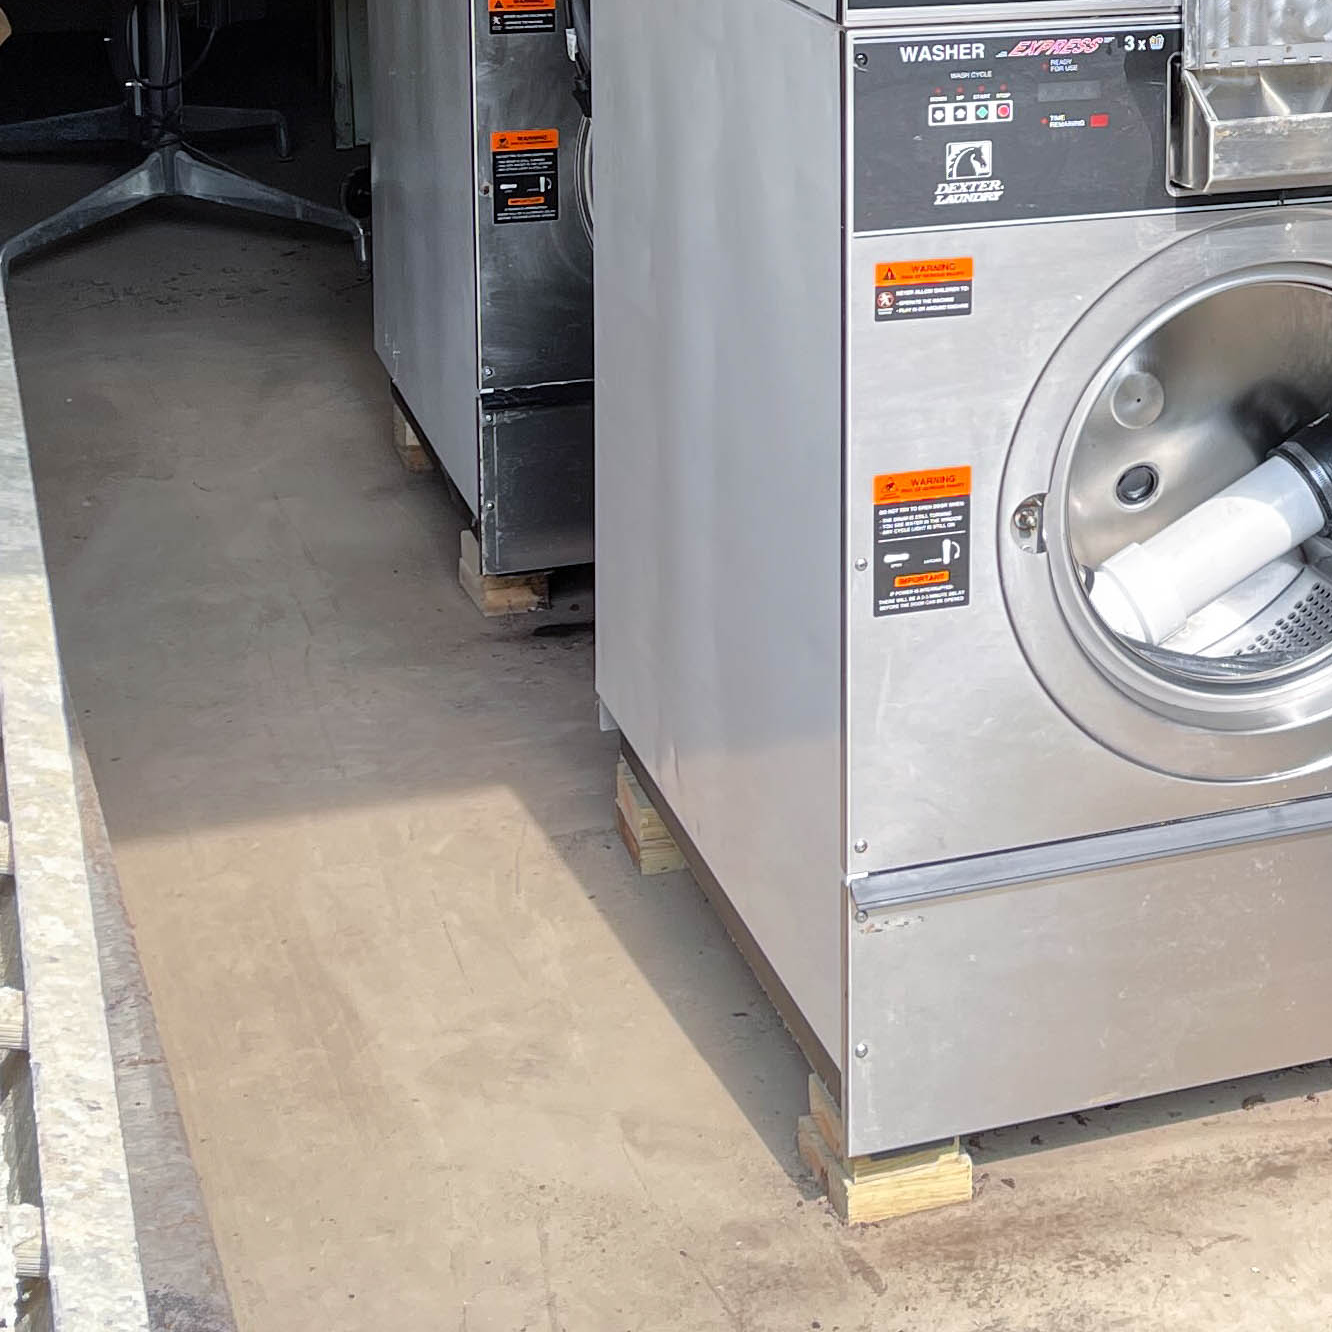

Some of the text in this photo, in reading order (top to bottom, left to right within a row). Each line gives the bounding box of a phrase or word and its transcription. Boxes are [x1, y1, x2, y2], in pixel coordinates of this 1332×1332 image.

[899, 35, 1146, 63] WASHER EXPRESS 3 x
[970, 70, 992, 78] CYCLE
[934, 179, 1002, 195] DEXTER
[933, 191, 1004, 205] LAUNDRY
[912, 263, 956, 274] WARNING
[911, 474, 956, 486] WARNING
[898, 573, 945, 585] IMPORTANT
